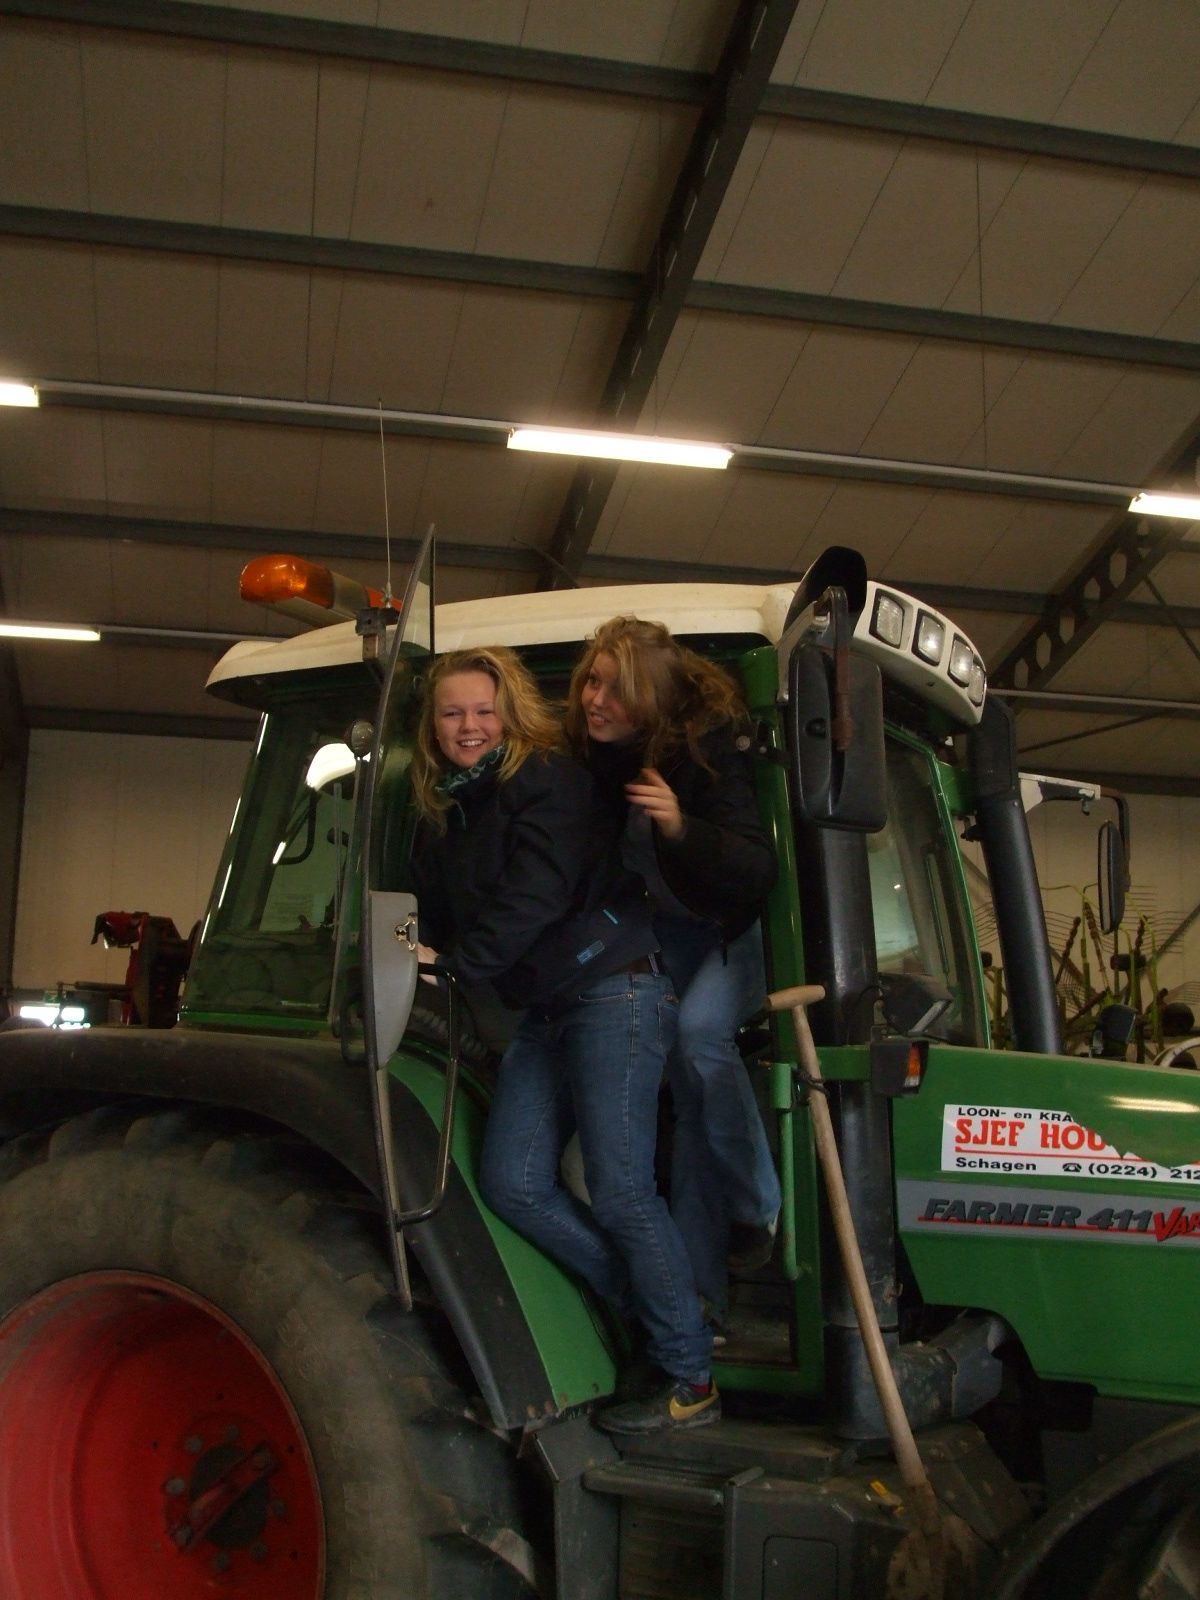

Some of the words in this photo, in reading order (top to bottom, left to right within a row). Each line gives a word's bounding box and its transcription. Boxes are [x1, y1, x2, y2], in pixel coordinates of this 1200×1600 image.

[958, 1107, 1006, 1118] LOON-
[1039, 1112, 1073, 1123] KRA
[955, 1118, 1025, 1147] SJEF
[955, 1157, 1037, 1172] Schagen
[1088, 1163, 1157, 1179] (0224)
[923, 1198, 1082, 1228] FARMER
[1086, 1207, 1153, 1232] 411
